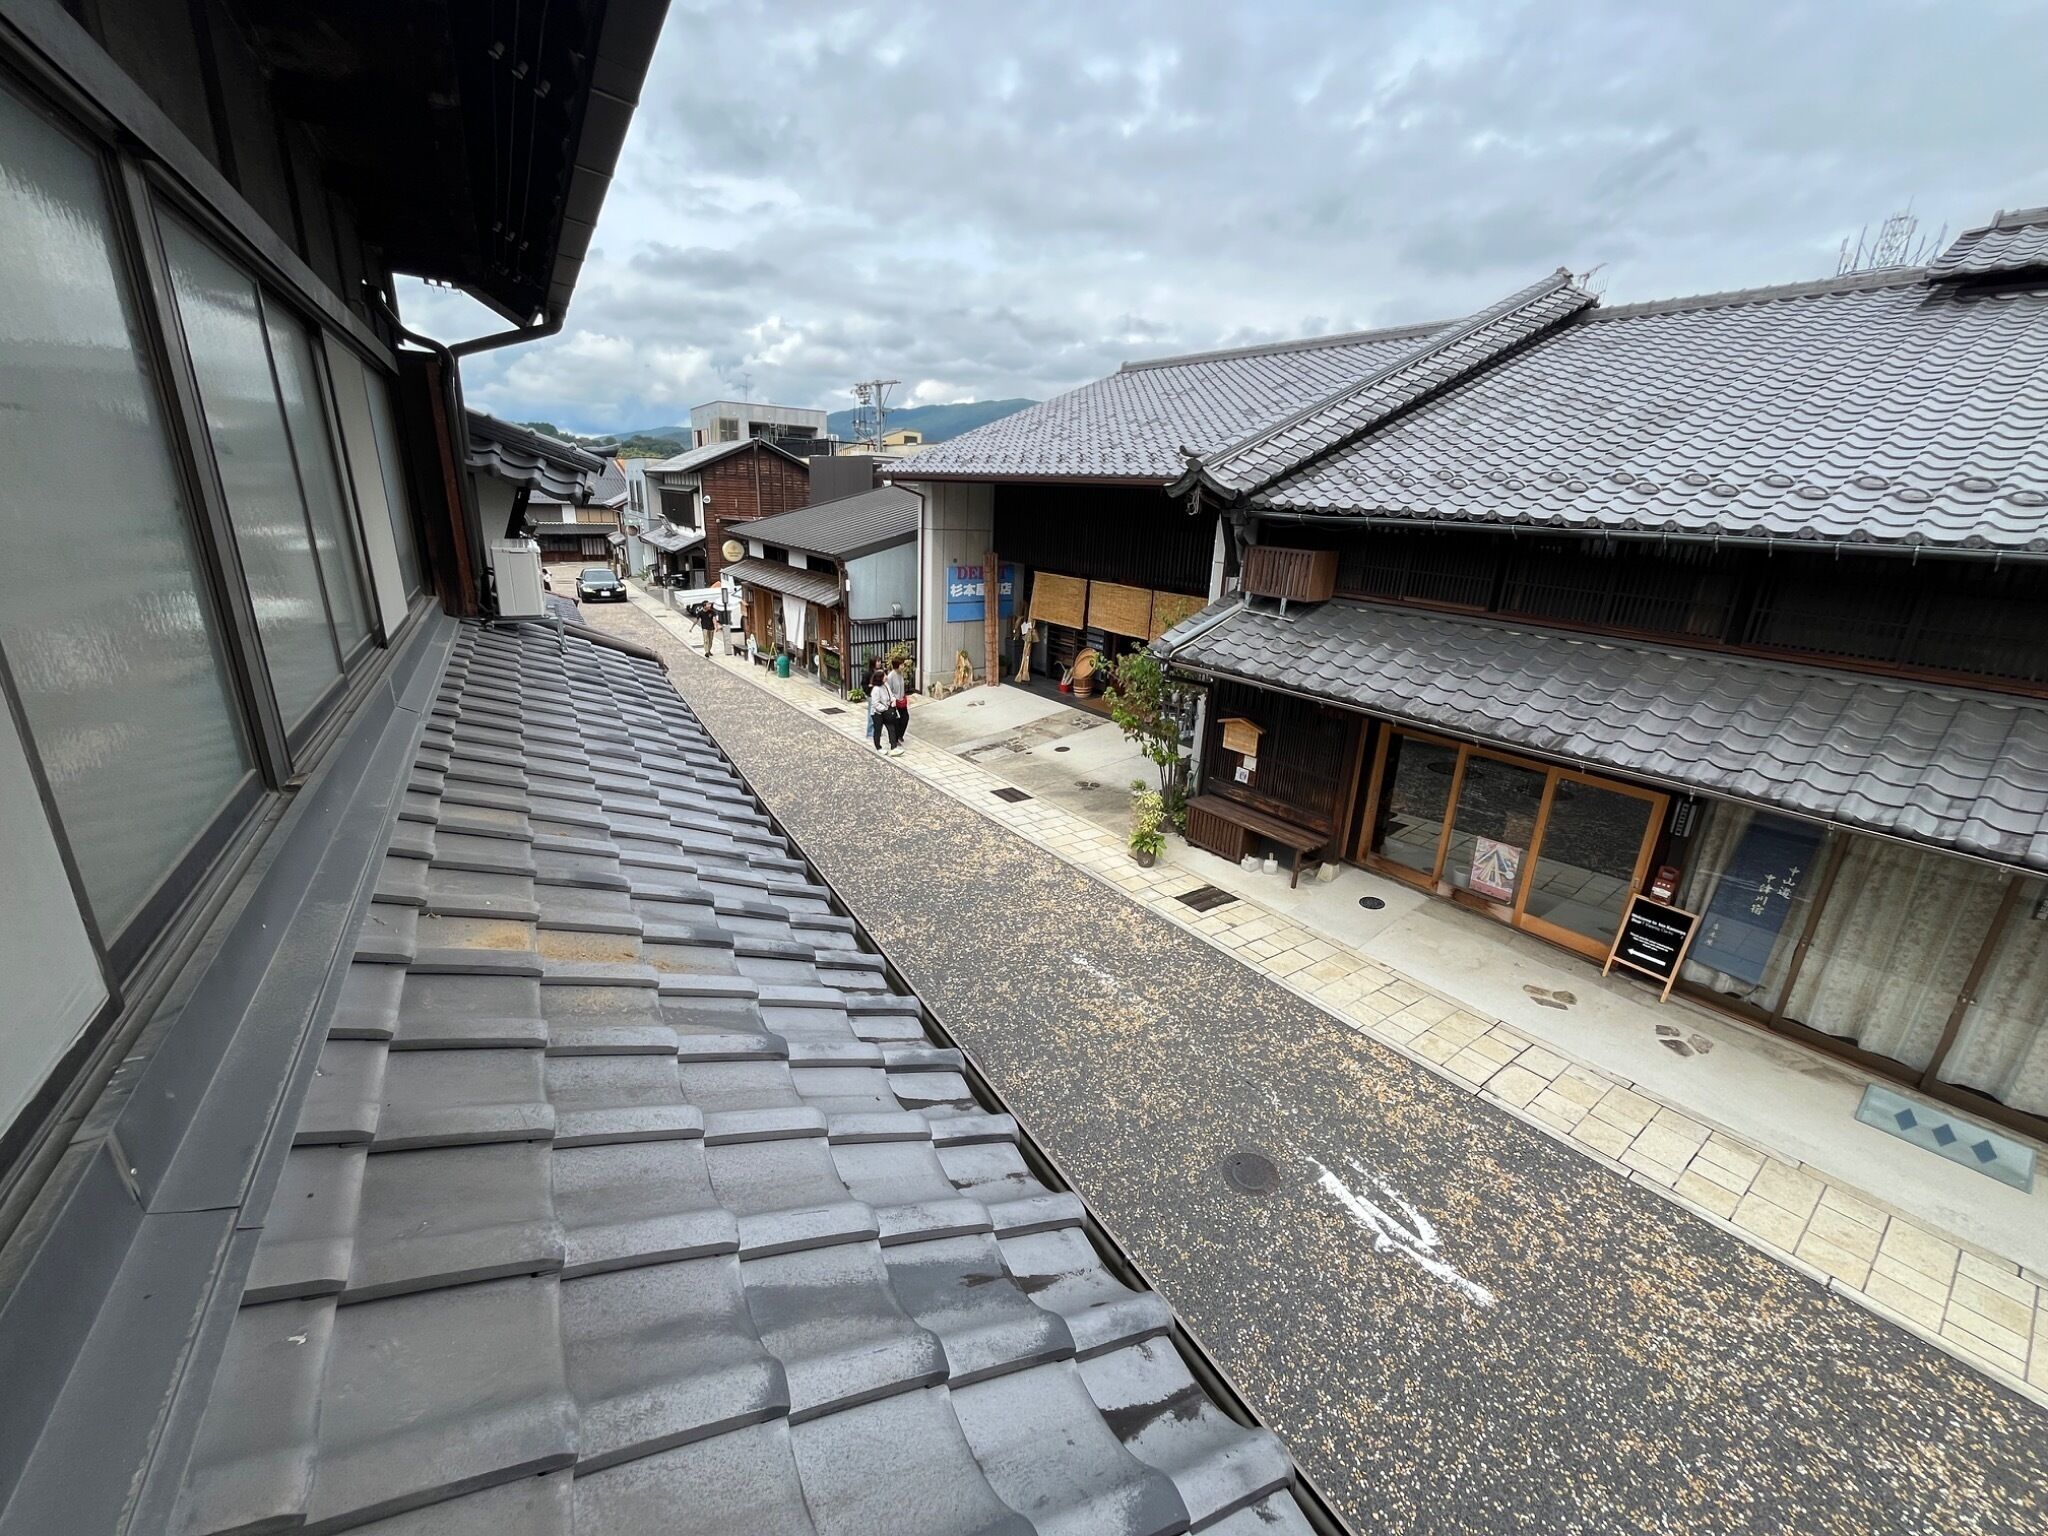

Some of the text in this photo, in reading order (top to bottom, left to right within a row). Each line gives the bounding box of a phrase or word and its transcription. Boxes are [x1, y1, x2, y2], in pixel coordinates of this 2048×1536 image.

[957, 566, 1007, 580] DET
[950, 583, 1012, 597] 杉本屋店
